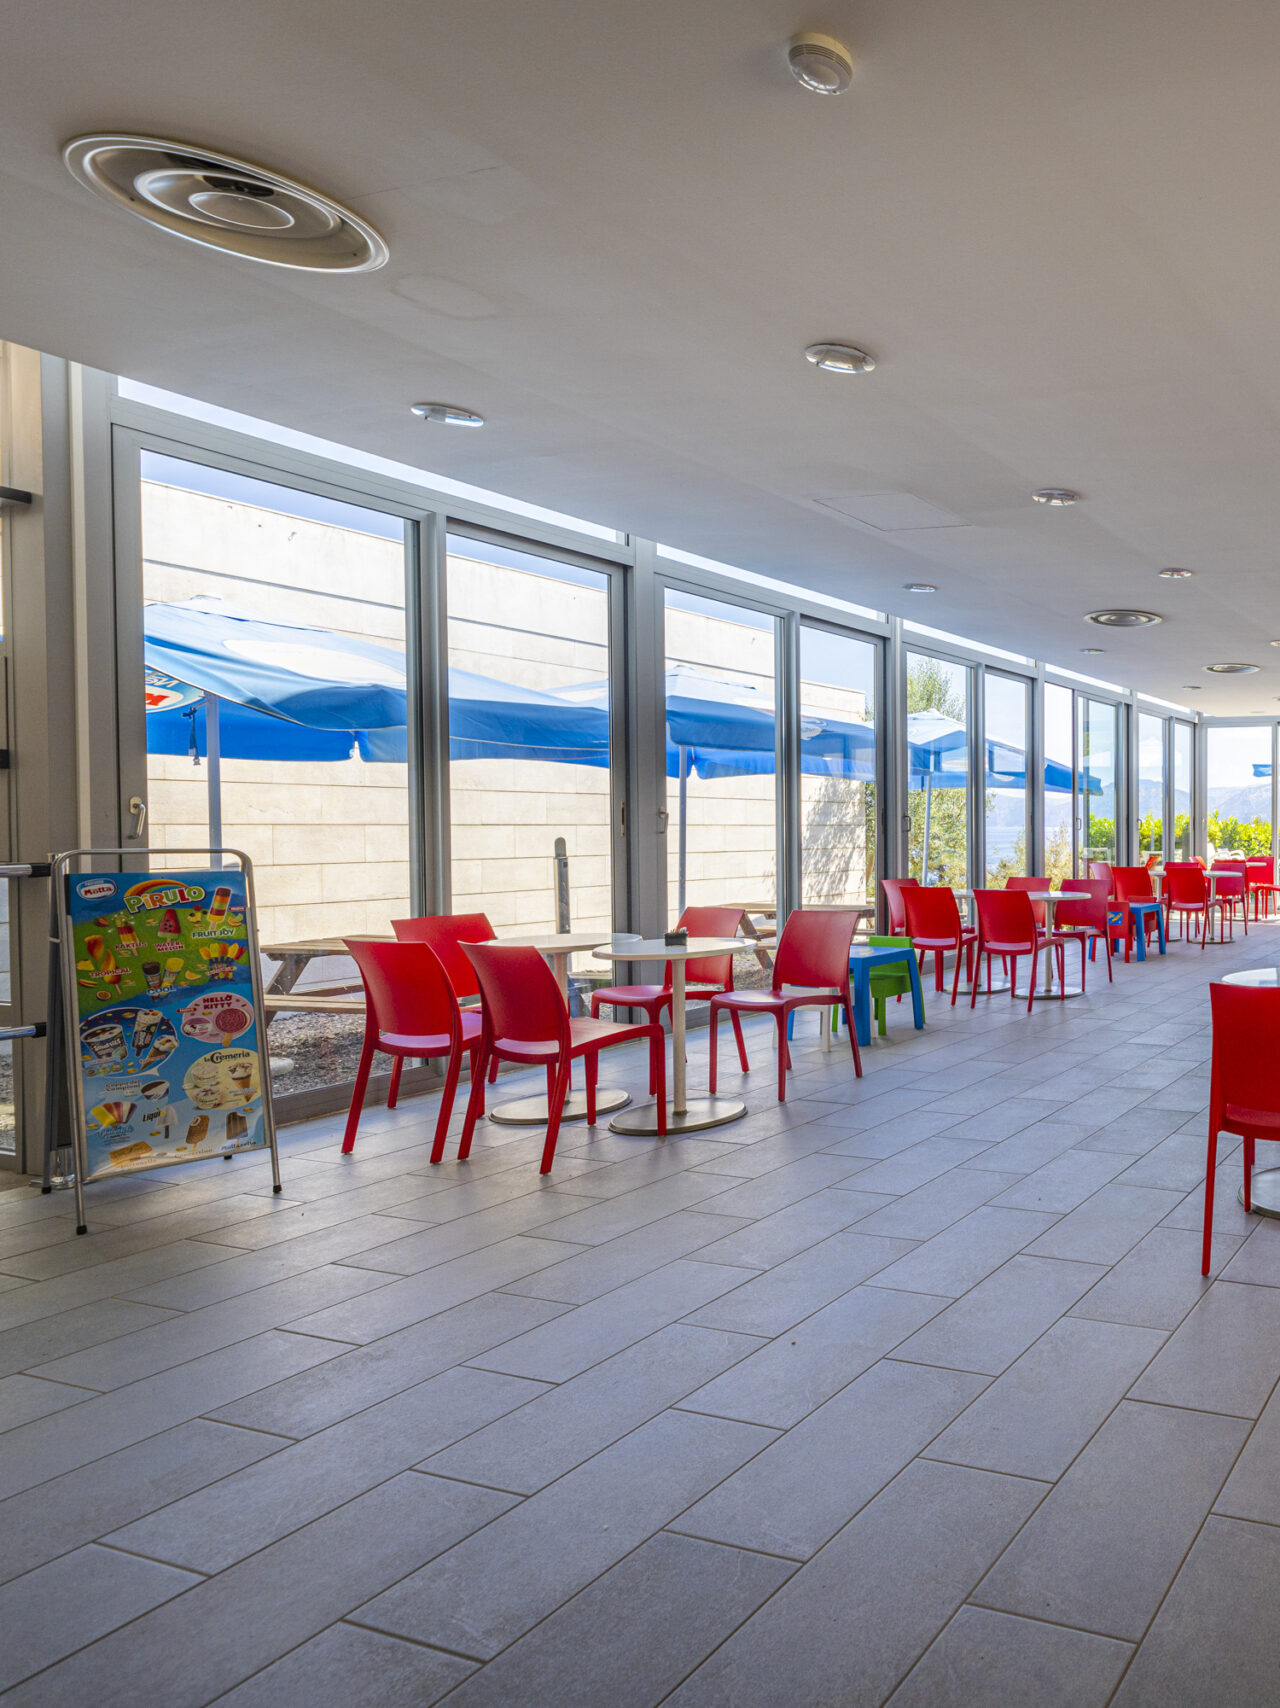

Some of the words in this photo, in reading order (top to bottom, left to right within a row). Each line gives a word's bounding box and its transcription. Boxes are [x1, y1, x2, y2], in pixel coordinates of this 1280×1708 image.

[83, 886, 112, 896] Motta
[192, 930, 217, 938] FRUIT
[220, 928, 234, 936] JOY
[115, 942, 147, 950] KAKTUS
[90, 968, 132, 978] TROPICAL
[203, 994, 233, 1003] HELLO
[210, 1050, 251, 1064] Cremeria
